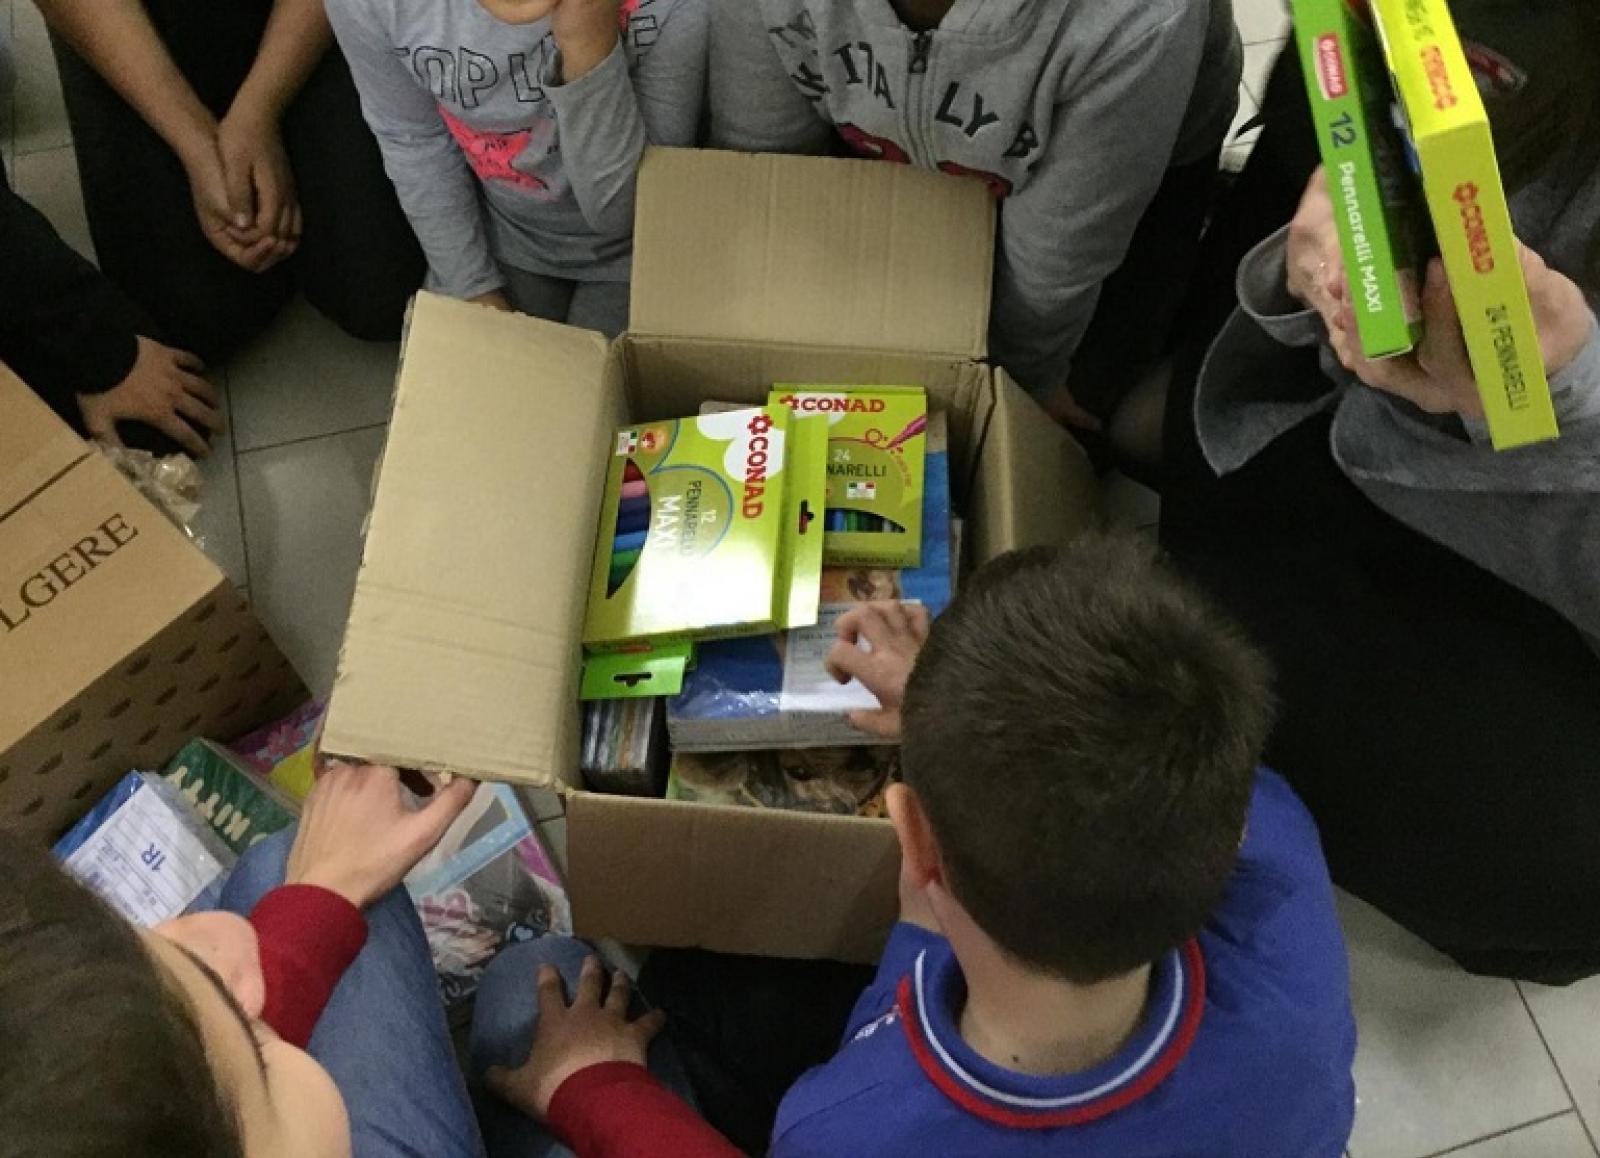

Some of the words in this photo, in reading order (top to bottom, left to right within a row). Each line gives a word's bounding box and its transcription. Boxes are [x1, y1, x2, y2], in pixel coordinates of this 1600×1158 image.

[1328, 111, 1357, 148] 12
[1339, 161, 1374, 265] Pennarelli
[1459, 203, 1495, 275] CONAD
[1361, 262, 1384, 313] MAXI
[801, 398, 885, 412] CONAD
[743, 436, 769, 519] CONAD
[826, 464, 887, 477] NARELLI
[701, 509, 717, 524] 12
